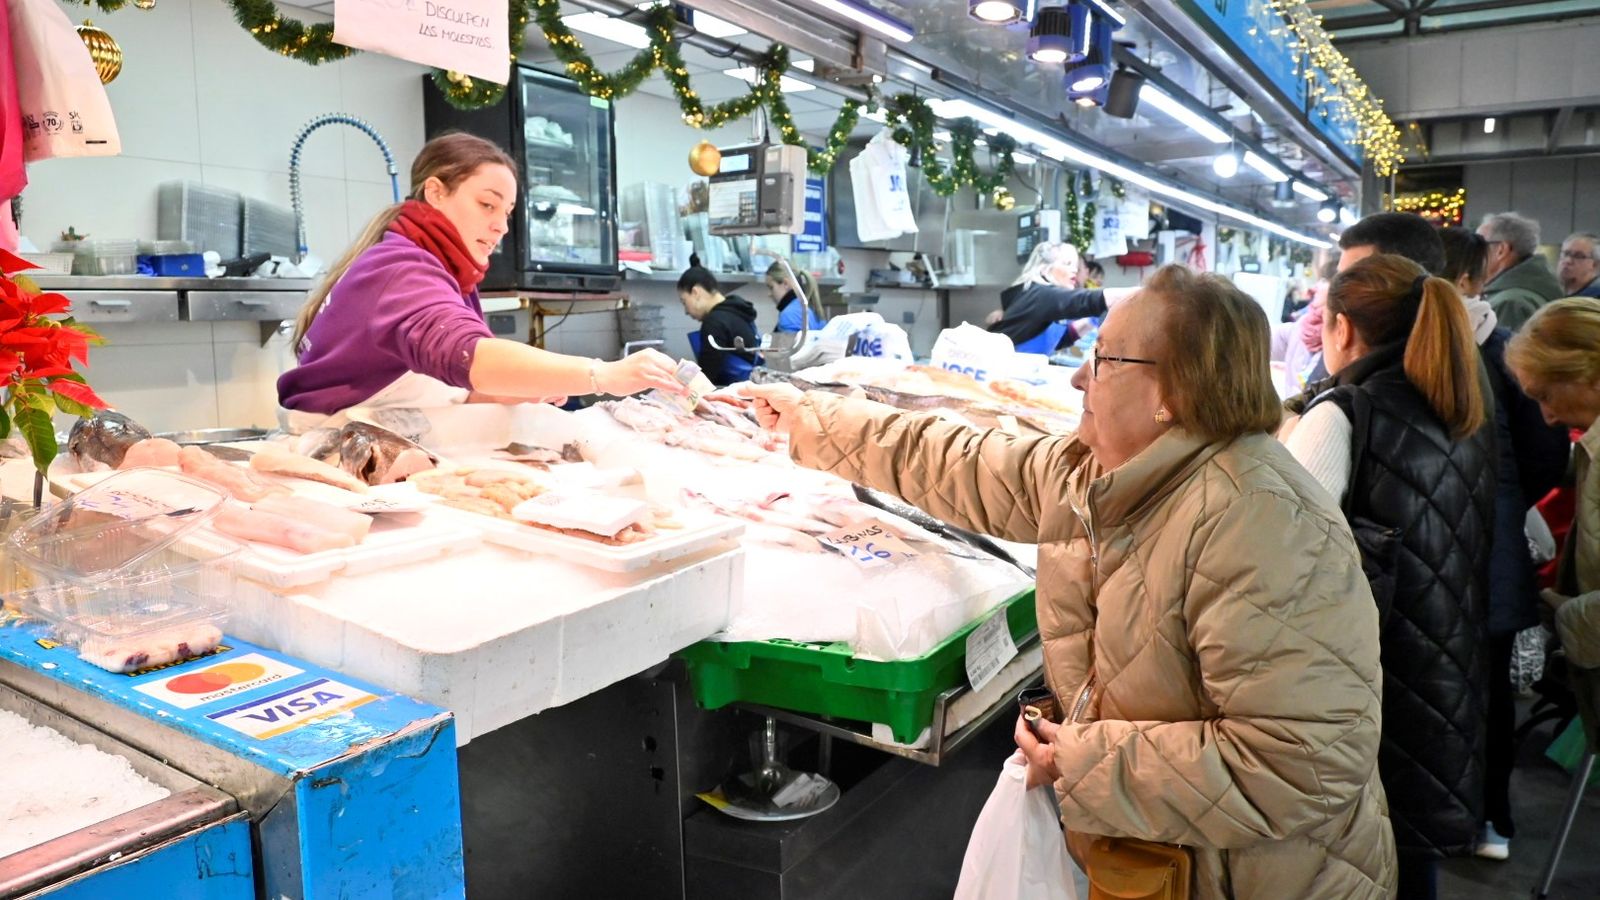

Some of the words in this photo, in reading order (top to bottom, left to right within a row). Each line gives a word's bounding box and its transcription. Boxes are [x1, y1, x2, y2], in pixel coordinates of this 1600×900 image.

[426, 1, 490, 28] DISCULPEN
[419, 23, 438, 38] LAS
[46, 118, 57, 127] 70
[200, 673, 282, 702] mastercard
[243, 691, 343, 723] VISA
